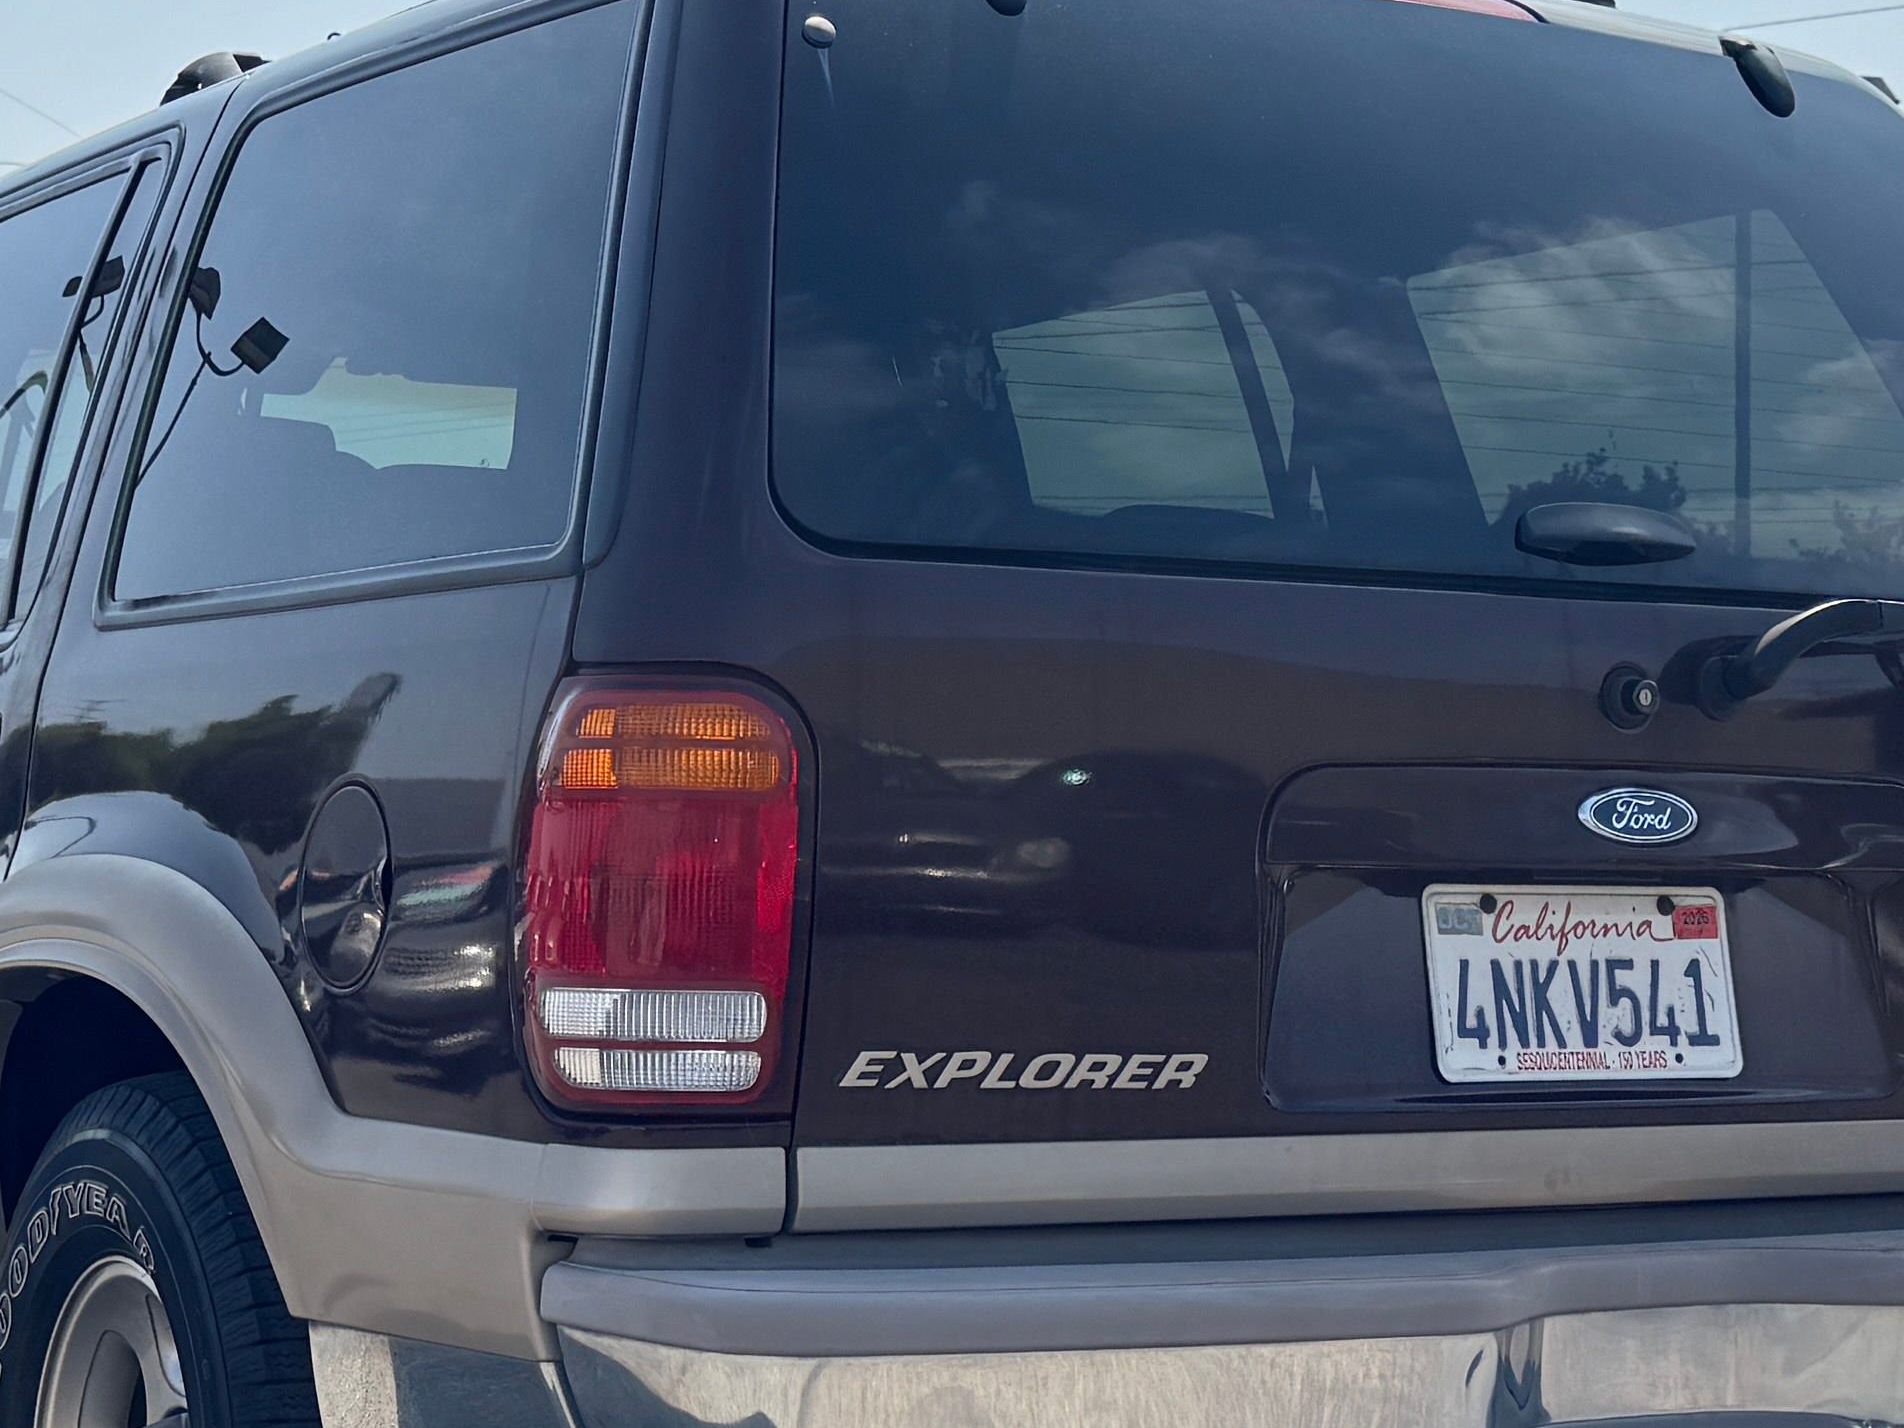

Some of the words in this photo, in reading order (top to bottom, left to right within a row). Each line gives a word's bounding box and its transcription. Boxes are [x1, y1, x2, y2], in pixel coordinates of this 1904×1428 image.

[1611, 796, 1673, 832] Ford
[1491, 899, 1675, 957] California
[1456, 957, 1721, 1051] 4NKV541
[837, 1049, 1209, 1091] EXPLORER
[1636, 1050, 1668, 1070] YEARS
